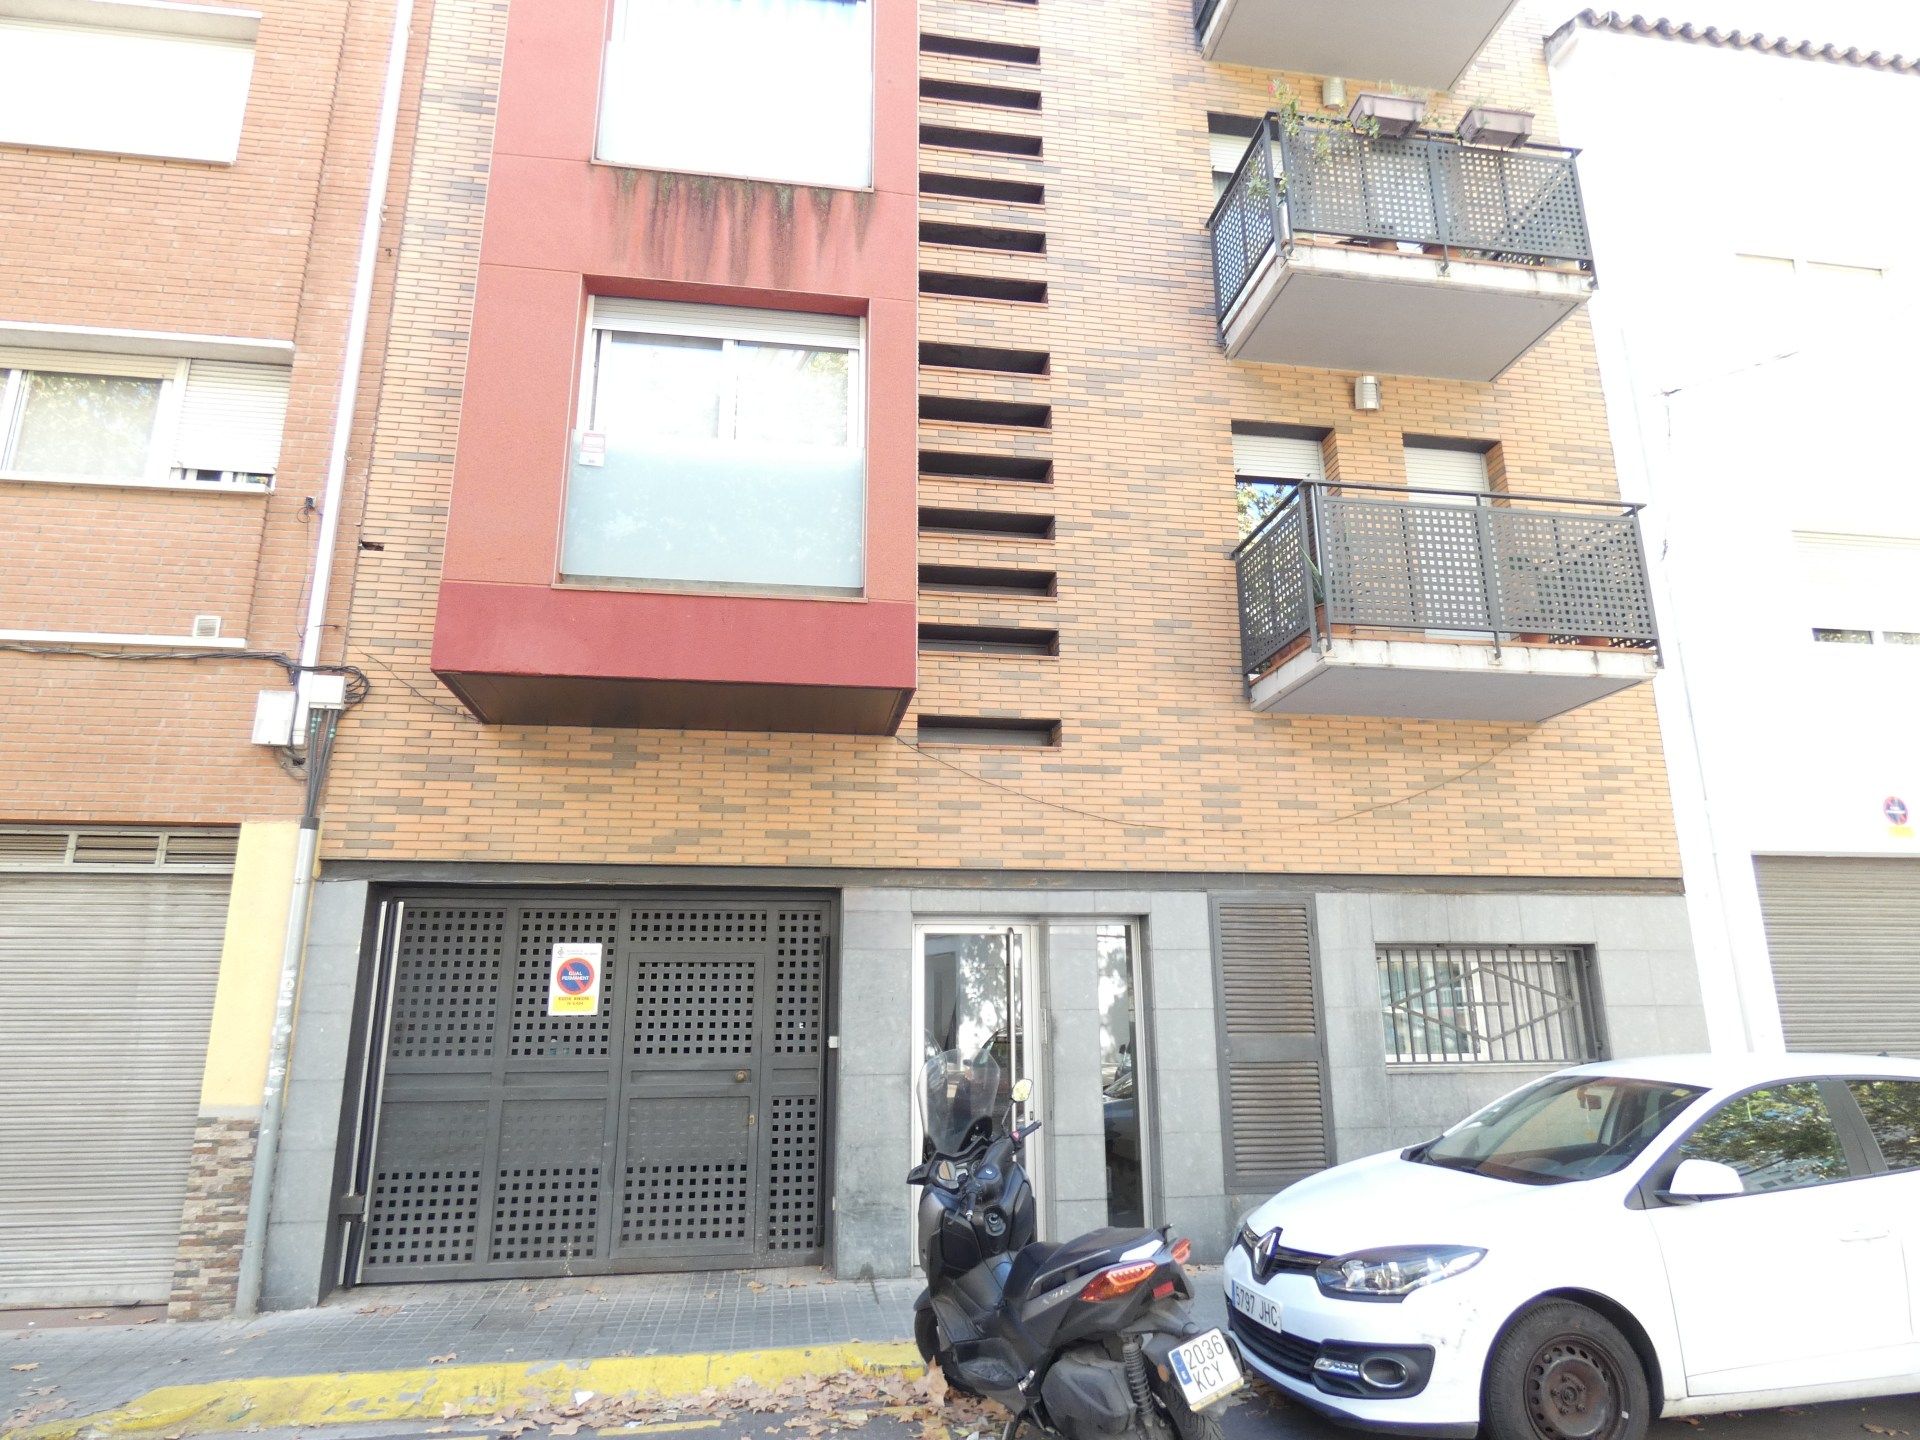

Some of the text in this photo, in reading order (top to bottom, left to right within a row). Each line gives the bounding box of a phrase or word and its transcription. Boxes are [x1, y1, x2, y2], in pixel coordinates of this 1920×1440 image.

[1235, 1286, 1278, 1327] 5797 JHC
[1183, 1334, 1224, 1370] 2036
[1193, 1360, 1224, 1392] KCY
